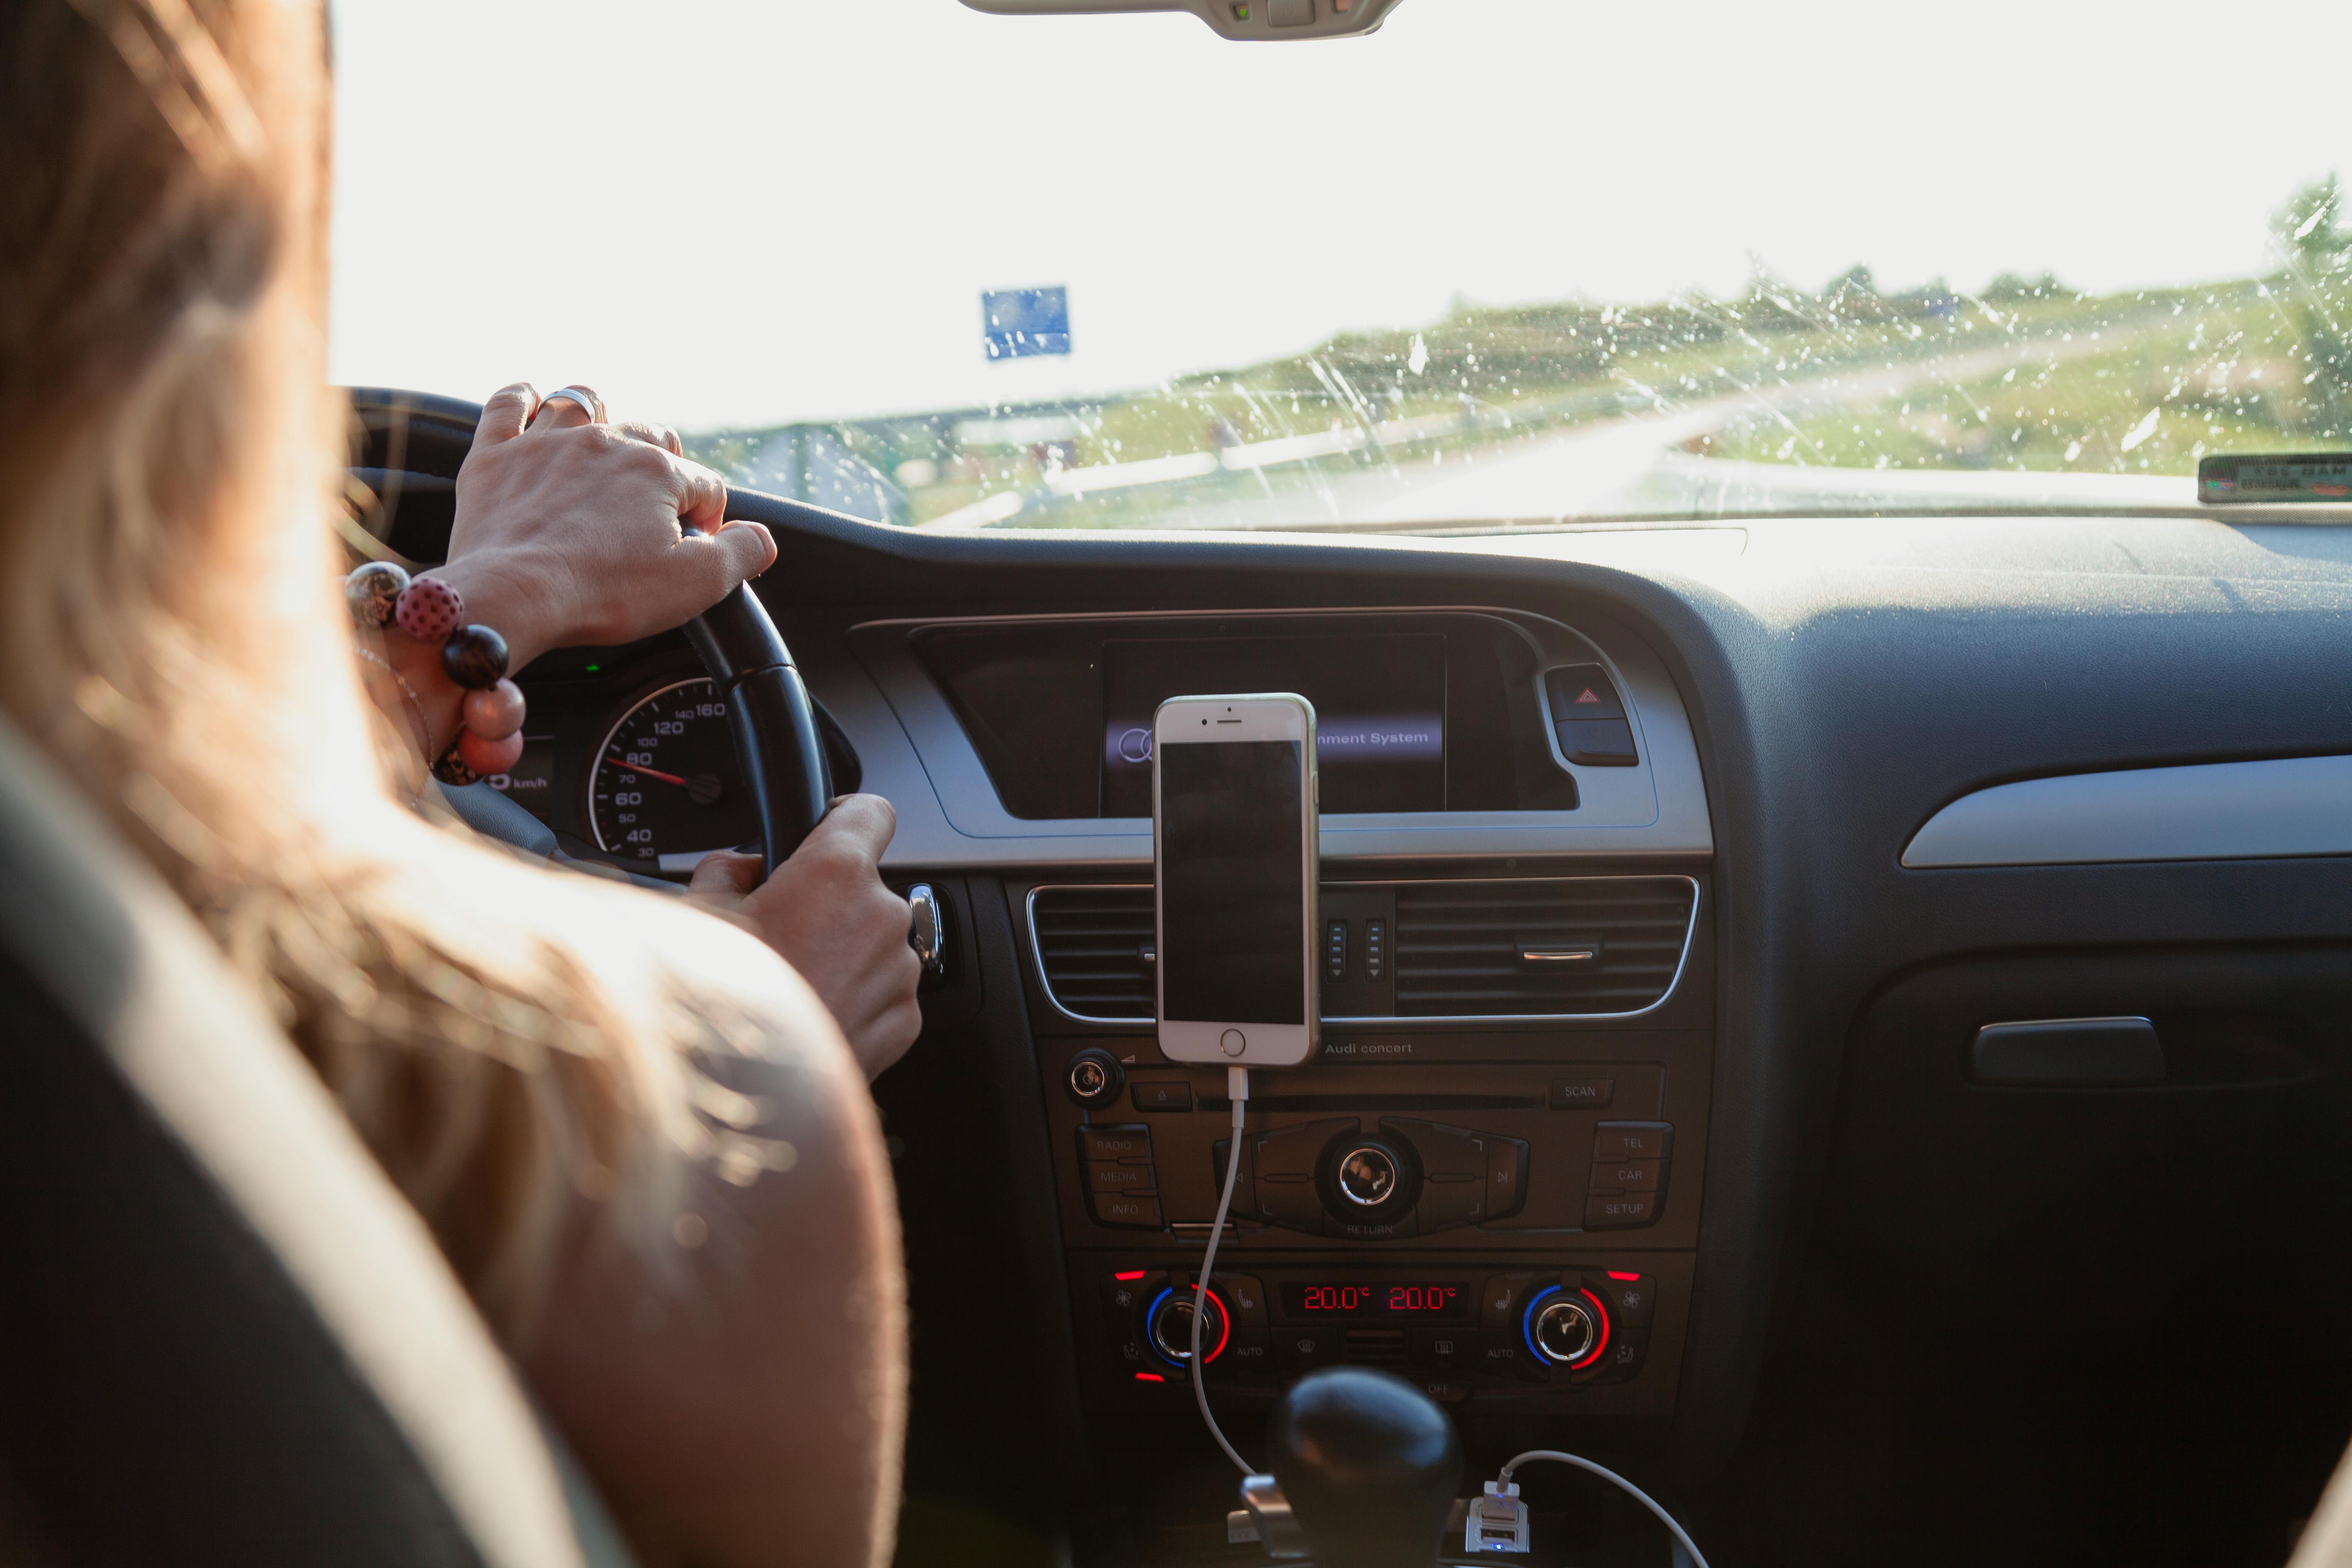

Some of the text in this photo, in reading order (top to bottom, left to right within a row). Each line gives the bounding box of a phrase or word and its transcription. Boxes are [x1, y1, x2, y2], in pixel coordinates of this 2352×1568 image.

[675, 710, 694, 719] 140
[696, 704, 725, 717] 160
[653, 721, 684, 734] 120
[637, 738, 658, 747] 100
[1371, 732, 1428, 745] System
[627, 753, 652, 765] 80
[514, 777, 547, 788] km/h
[619, 775, 636, 784] 70
[616, 792, 642, 805] 60
[619, 814, 636, 823] 50
[627, 829, 652, 842] 40
[638, 847, 655, 857] 30
[1325, 1043, 1412, 1054] Audi concert
[1565, 1086, 1595, 1096] SCAN
[1097, 1140, 1131, 1150] RADIO
[1623, 1138, 1643, 1148] TEL
[1101, 1172, 1136, 1181] MEDIA
[1619, 1170, 1642, 1180] CAR
[1112, 1204, 1139, 1214] INFO
[1606, 1203, 1643, 1213] SETUP
[1348, 1224, 1393, 1234] RETURN
[1237, 1346, 1263, 1357] AUTO
[1488, 1349, 1514, 1358] AUTO
[1428, 1383, 1449, 1393] OFF
